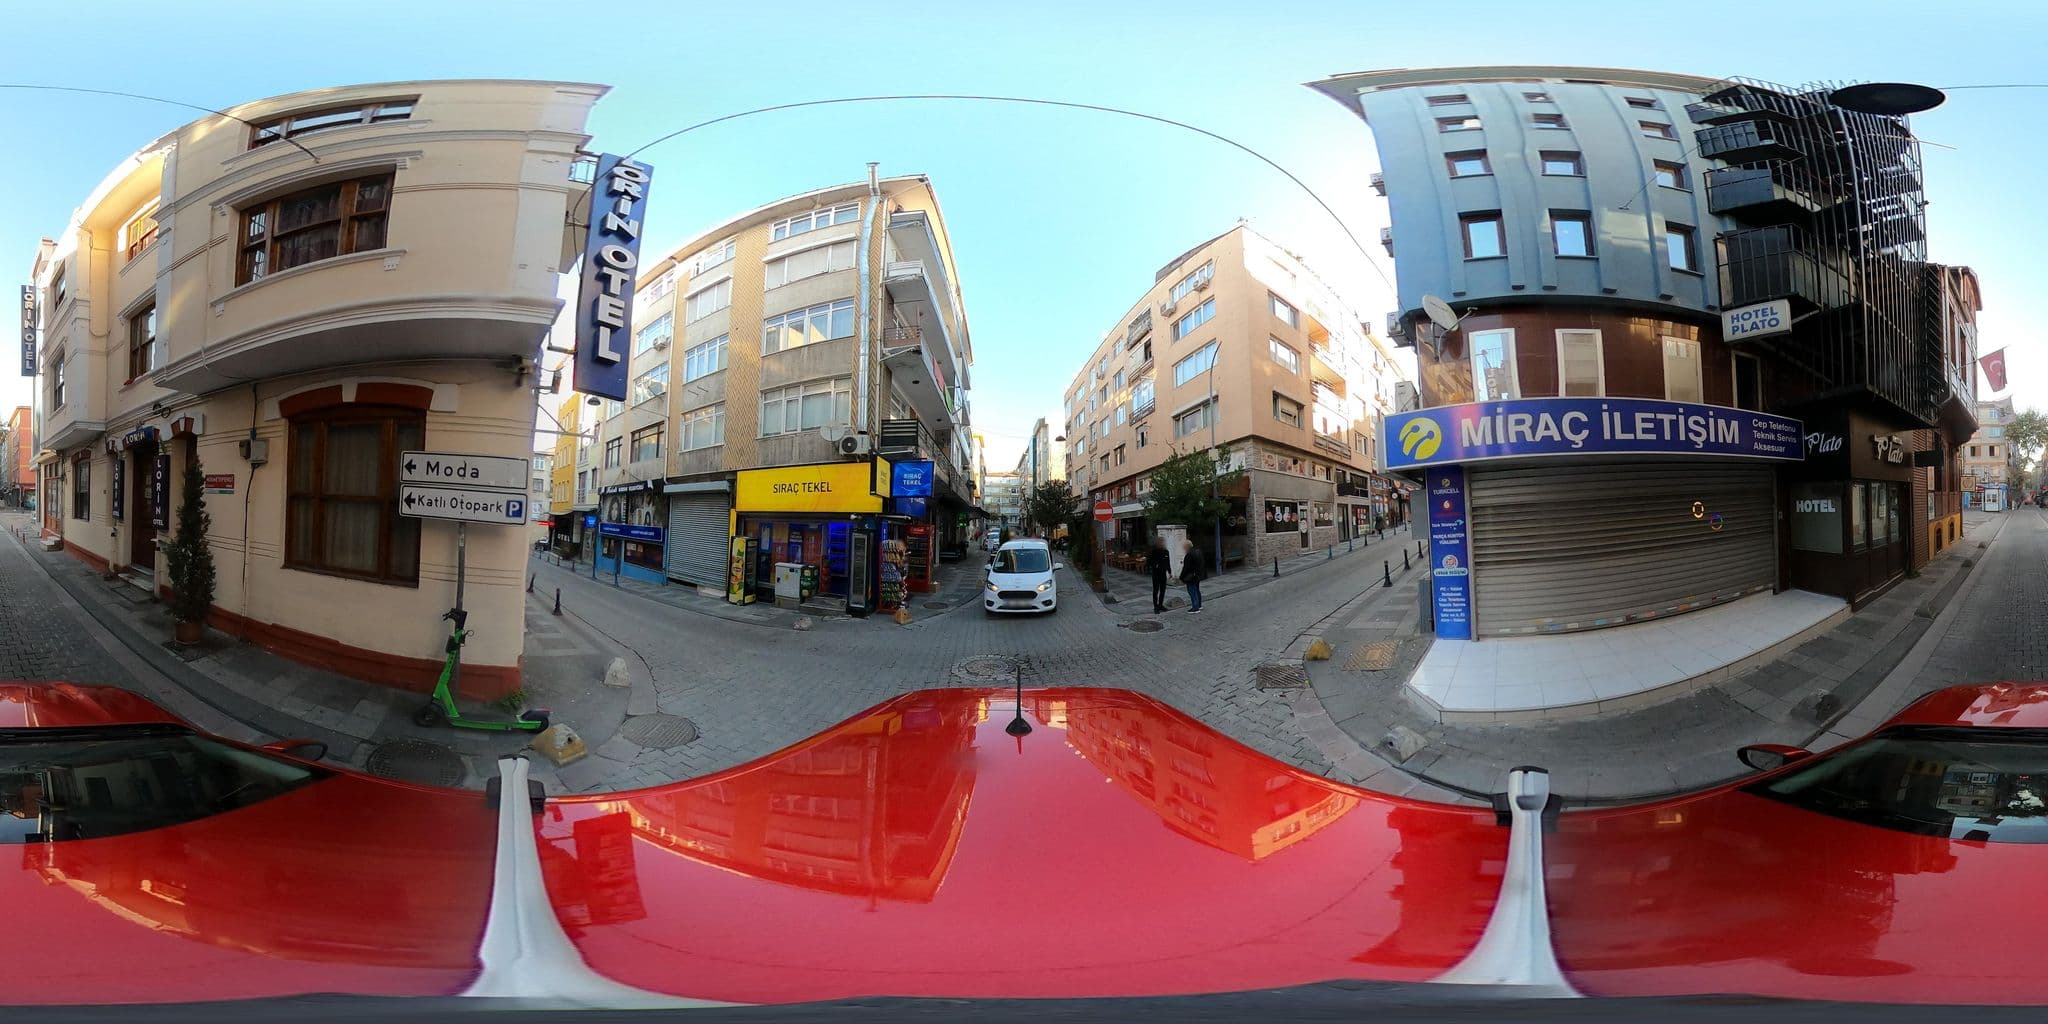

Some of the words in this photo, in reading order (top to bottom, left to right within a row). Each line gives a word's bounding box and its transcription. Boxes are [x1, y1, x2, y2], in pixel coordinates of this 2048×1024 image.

[603, 159, 649, 241] LORİN
[598, 244, 637, 363] OTEL
[1731, 306, 1779, 324] HOTEL
[1732, 317, 1780, 335] PLATO
[24, 333, 35, 369] OTEL
[1461, 407, 1590, 448] MİRAÇ
[1601, 404, 1740, 449] İLETİŞİM
[1752, 418, 1768, 430] Cep
[1769, 420, 1796, 433] Telefonu
[1752, 430, 1776, 441] Teknik
[1777, 432, 1797, 444] Servis
[1805, 432, 1843, 455] Plato
[1753, 441, 1786, 453] Aksesuar
[1874, 434, 1904, 463] Plato
[425, 461, 480, 479] Moda
[773, 483, 800, 496] SIRAÇ
[801, 481, 833, 493] TEKEL
[417, 494, 446, 508] Katlı
[450, 497, 504, 514] Otopark
[1796, 499, 1836, 513] HOTEL
